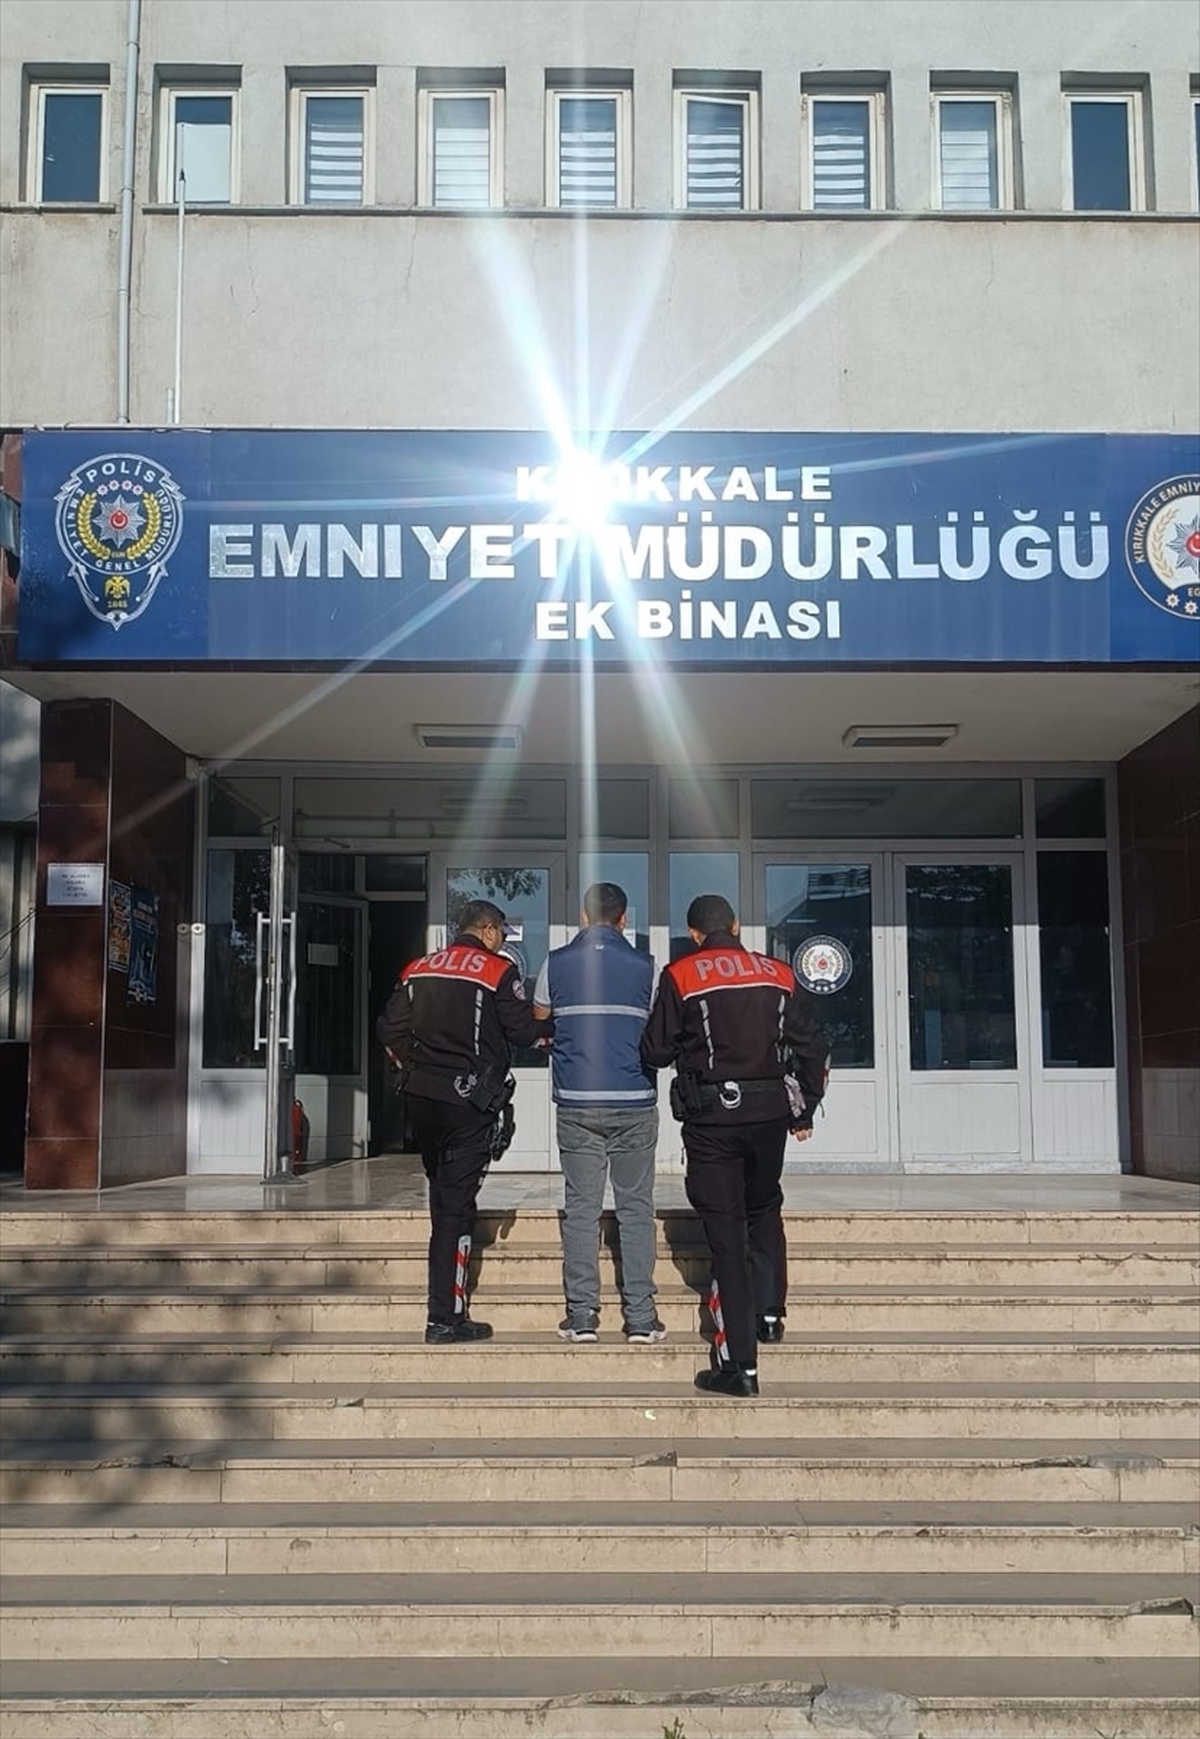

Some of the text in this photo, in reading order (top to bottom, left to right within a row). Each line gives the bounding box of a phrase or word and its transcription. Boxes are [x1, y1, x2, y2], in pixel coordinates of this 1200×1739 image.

[86, 462, 156, 484] POLİS
[516, 466, 832, 501] KIKKALE
[605, 508, 1110, 581] MÜDÜRLÜĞÜ
[1133, 497, 1161, 564] KIRIKKALE
[95, 560, 140, 571] GENEL
[535, 589, 841, 640] EK BİNASI
